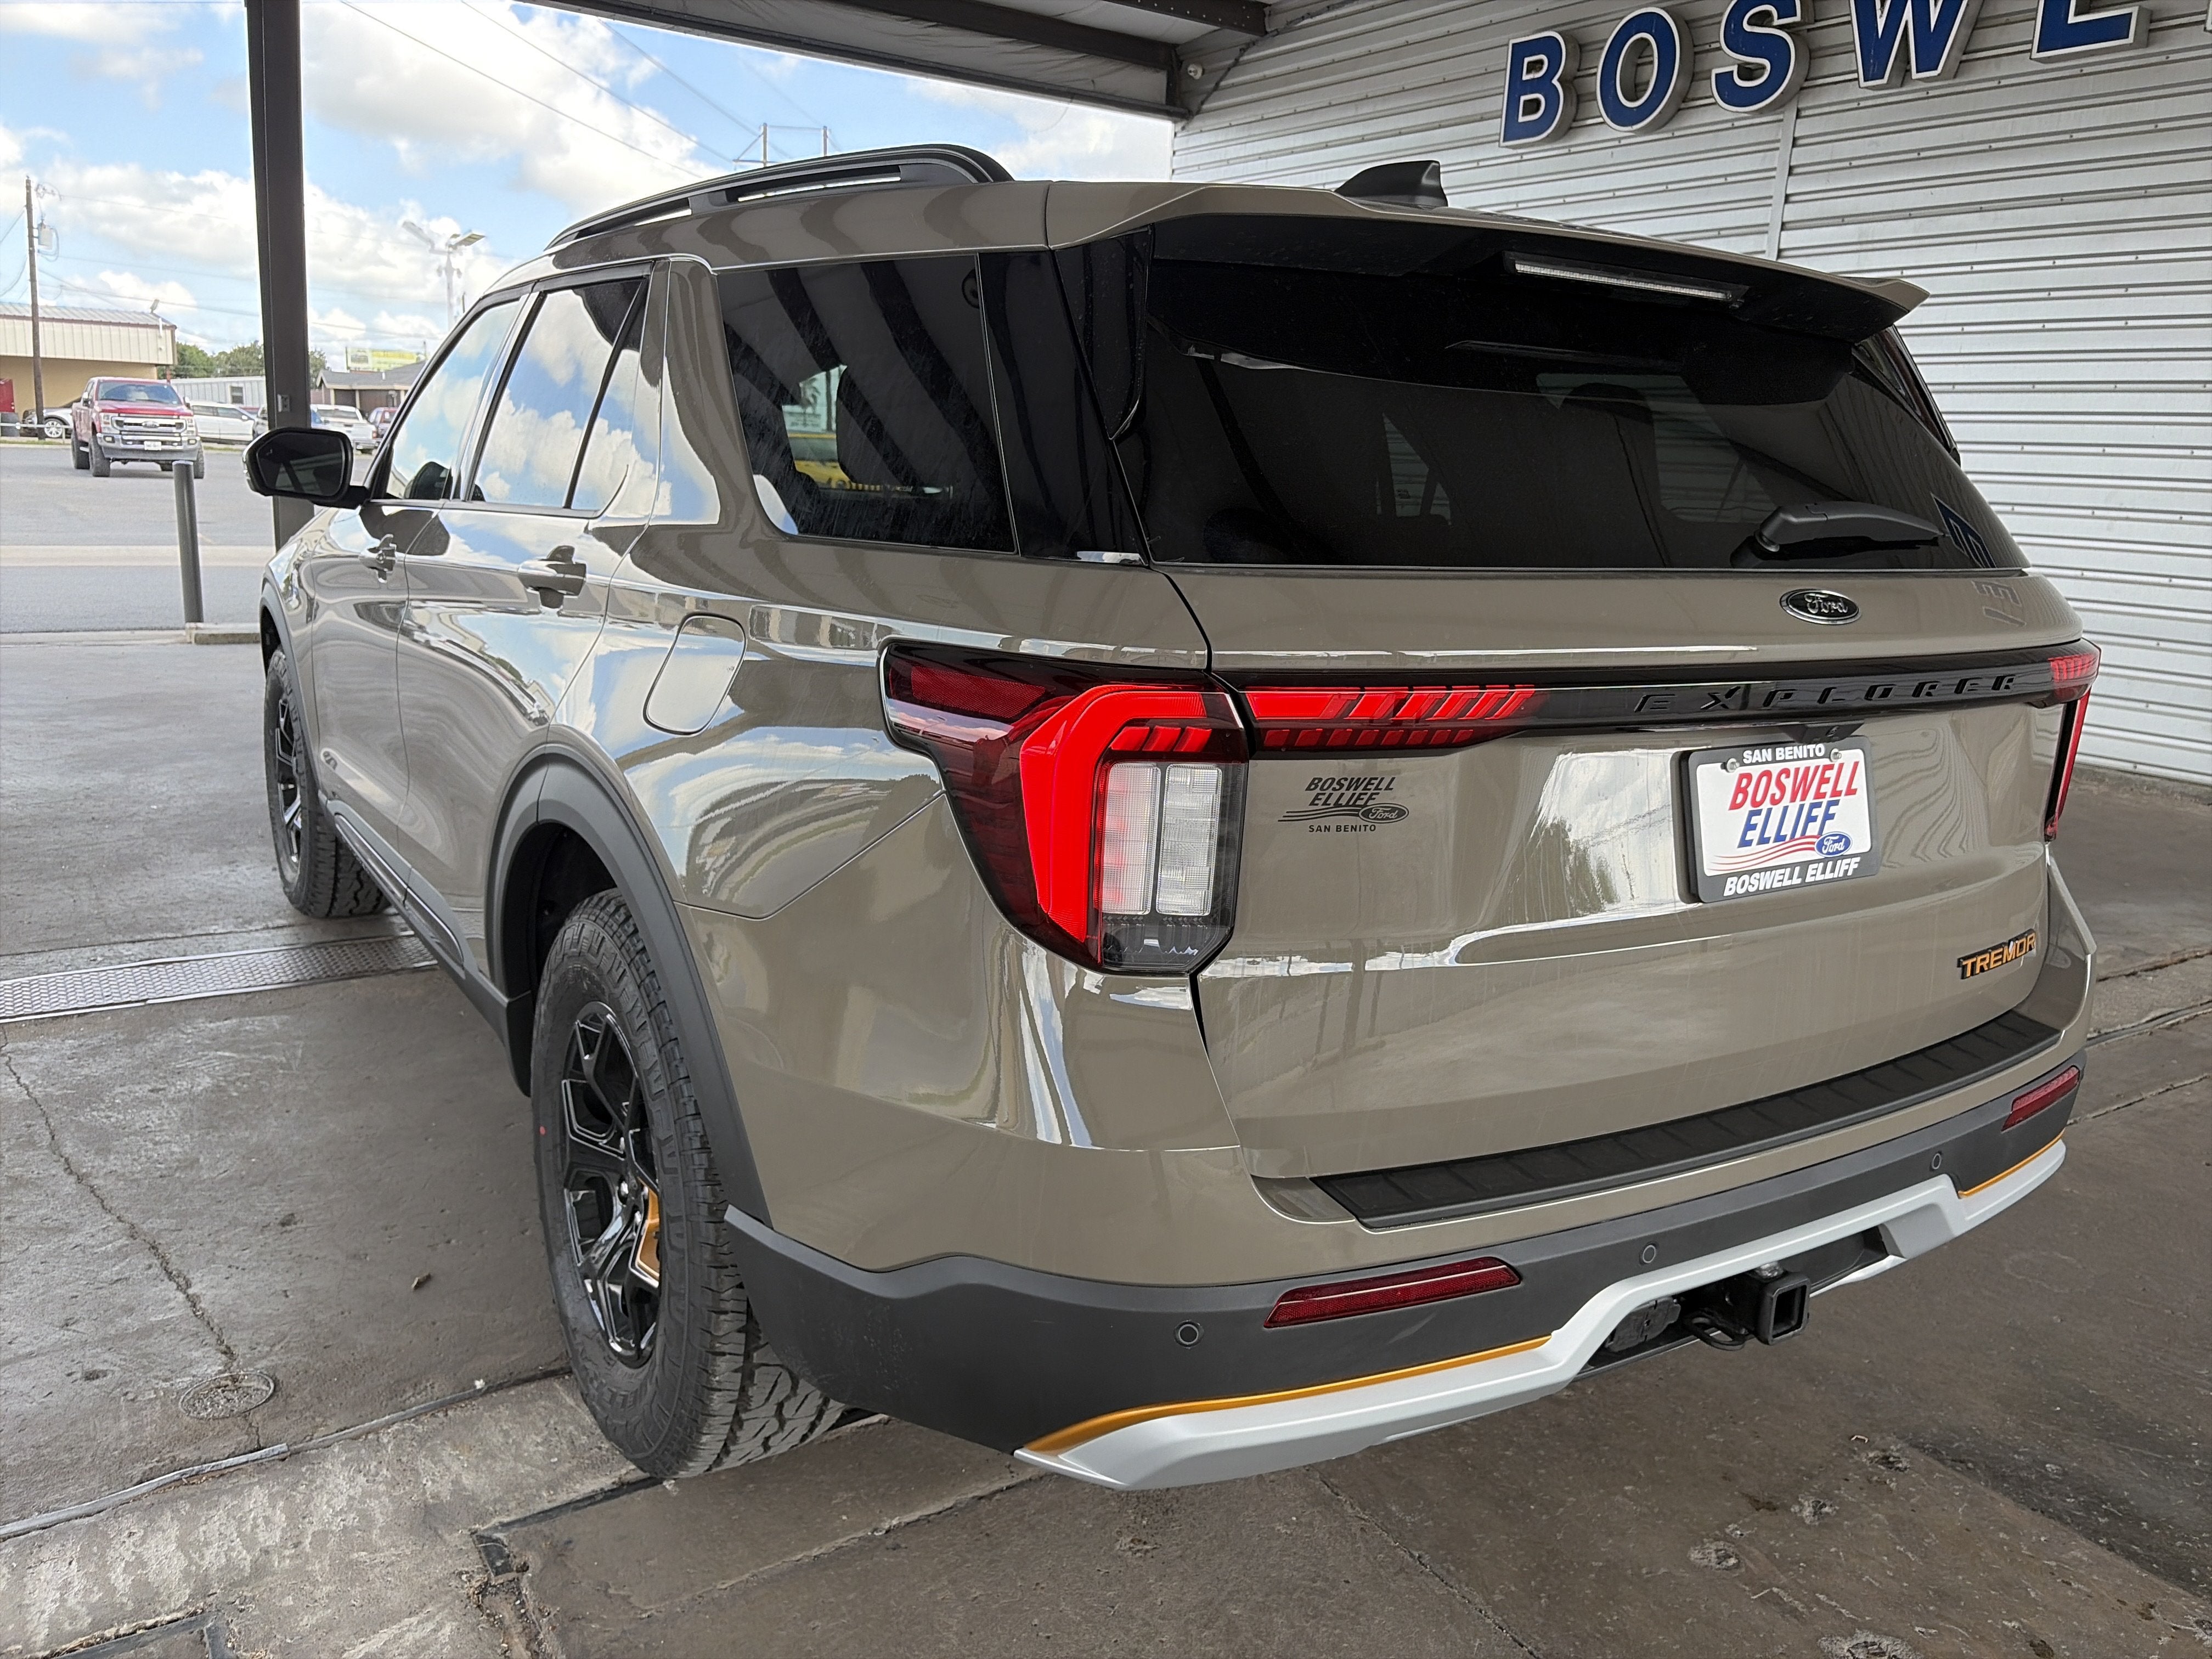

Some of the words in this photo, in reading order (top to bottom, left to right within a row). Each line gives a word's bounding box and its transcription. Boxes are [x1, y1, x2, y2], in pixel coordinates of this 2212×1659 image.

[1804, 593, 1848, 614] Ford
[1634, 674, 2017, 713] EXPLORER
[1742, 749, 1772, 764] SAN
[1776, 743, 1825, 760] BENITO
[1305, 777, 1396, 791] BOSWELL
[1728, 761, 1859, 811] BOSWELL
[1308, 792, 1379, 806] ELLIFF
[1368, 806, 1397, 820] Ford
[1336, 824, 1376, 832] BENITO
[1737, 799, 1839, 849] ELLIFF
[1822, 836, 1845, 854] Ford
[1723, 866, 1802, 896] BOSWELL
[1805, 857, 1860, 883] ELLIFF
[1957, 930, 2036, 979] TREMOR
